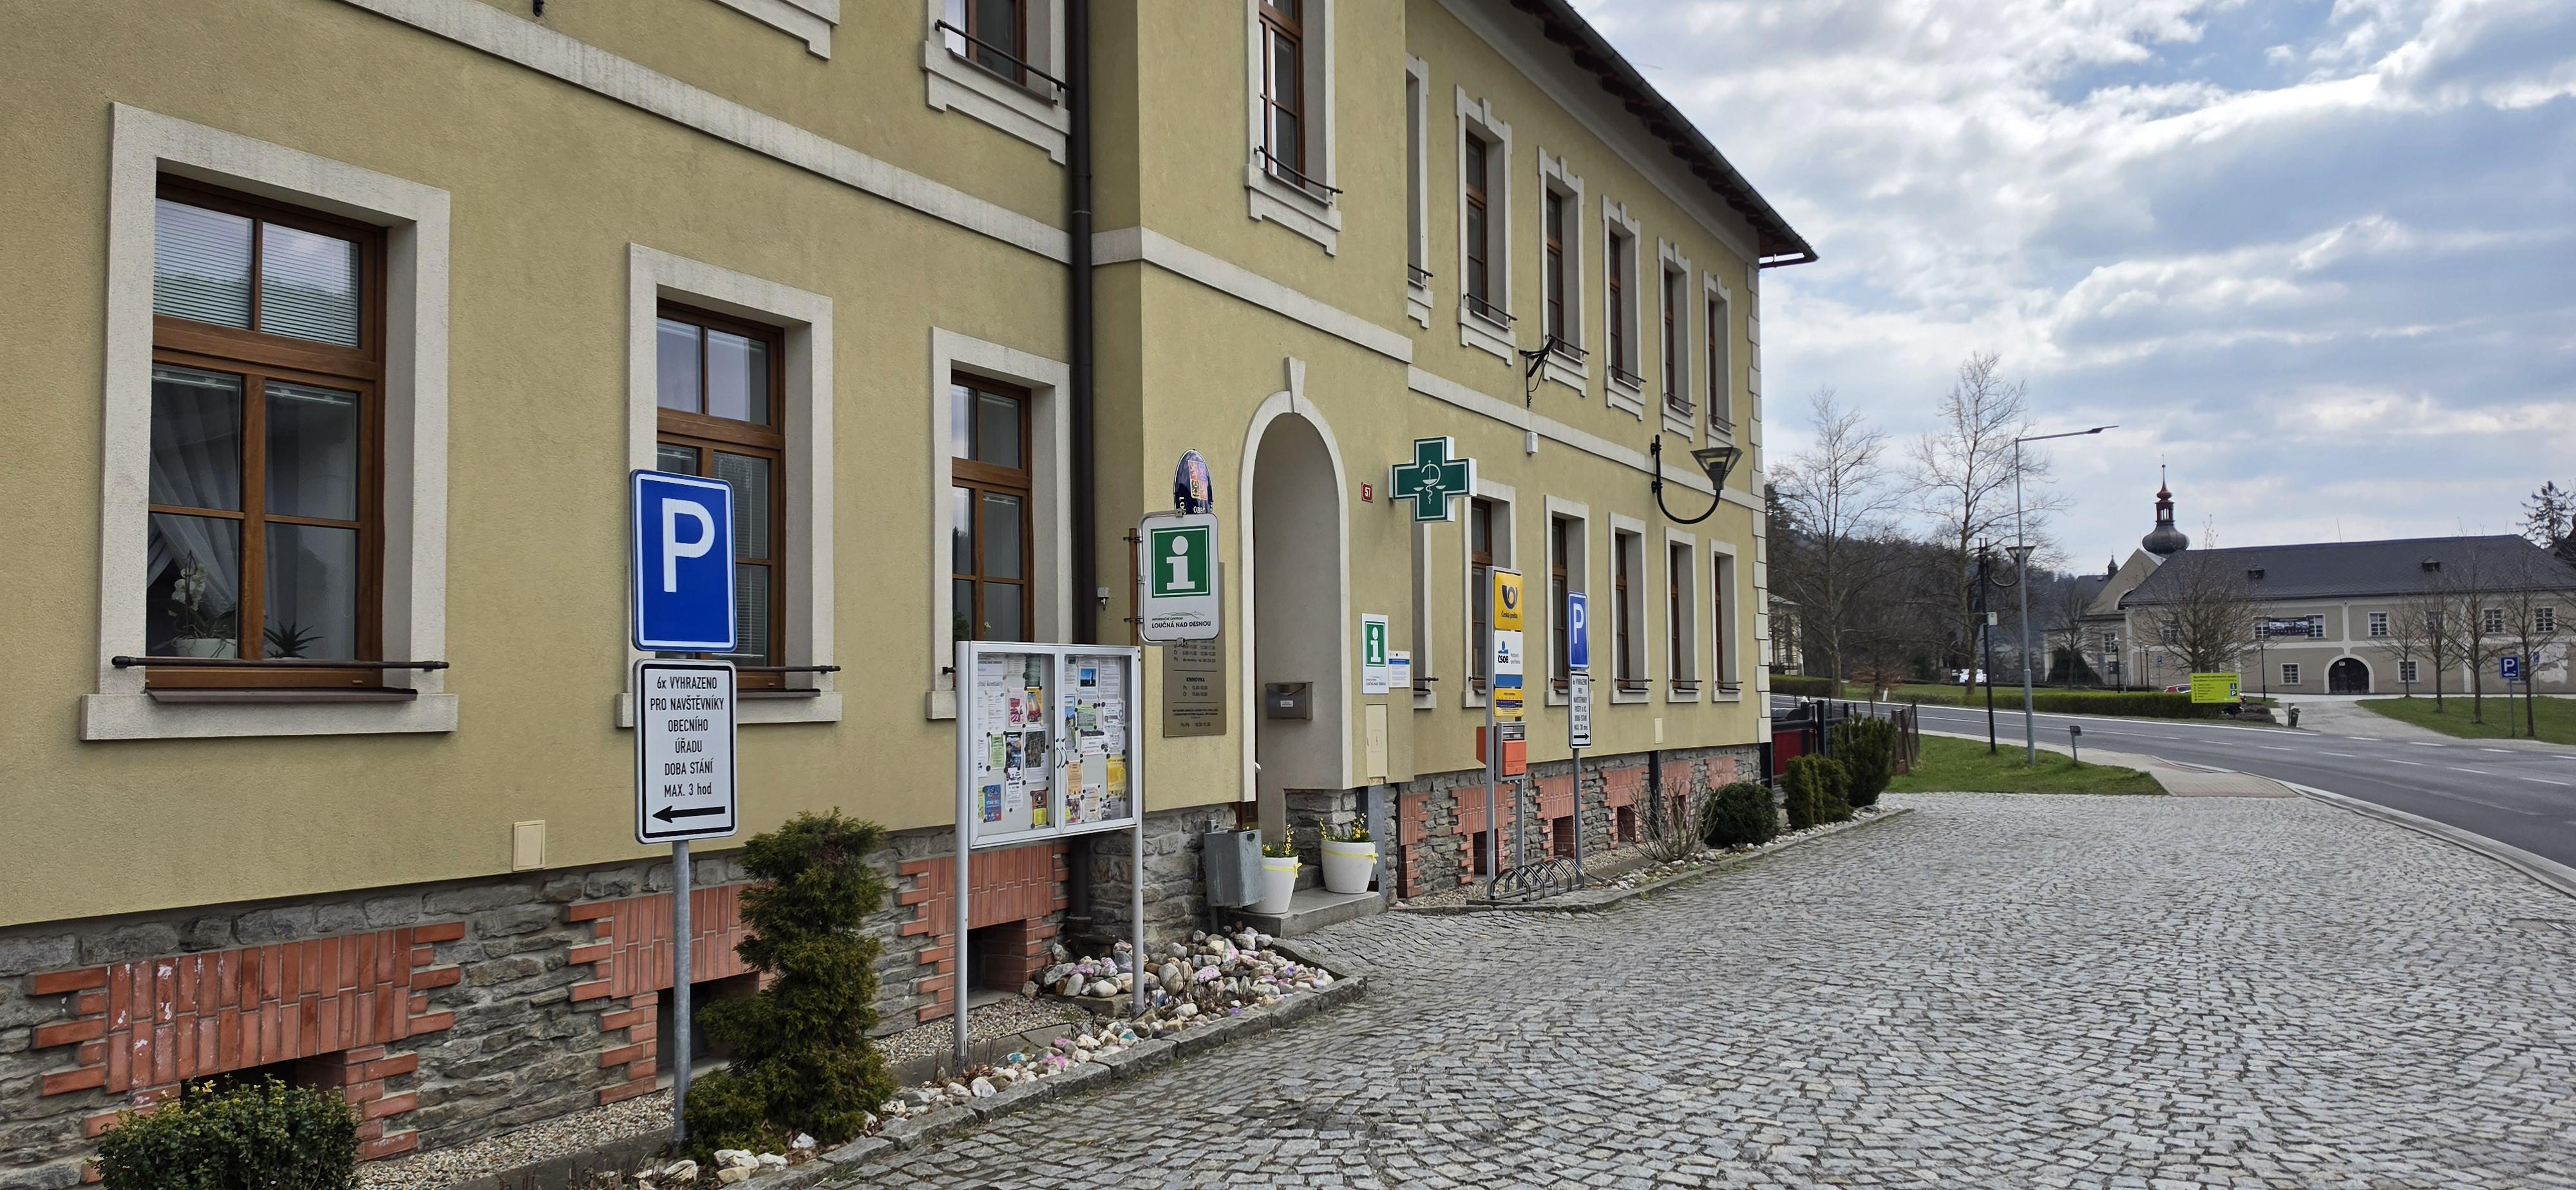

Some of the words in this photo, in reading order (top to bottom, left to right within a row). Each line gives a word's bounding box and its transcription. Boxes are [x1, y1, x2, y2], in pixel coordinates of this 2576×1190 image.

[1365, 486, 1371, 498] 57
[661, 497, 715, 593] P
[1573, 603, 1584, 645] P
[1497, 654, 1509, 664] ČSOB
[2504, 659, 2515, 672] P
[657, 676, 667, 690] 6x
[670, 676, 717, 690] VYHRAZENO
[650, 697, 667, 711] PRO
[670, 694, 724, 711] NAVŠTĚVNÍKY
[668, 715, 708, 732] OBECNÍHO
[675, 737, 703, 753] ÚŘADU
[665, 762, 687, 776] DOBA
[690, 757, 714, 774] STÁNÍ
[664, 784, 685, 798] MAX.
[688, 783, 694, 796] 3
[697, 782, 712, 796] hod
